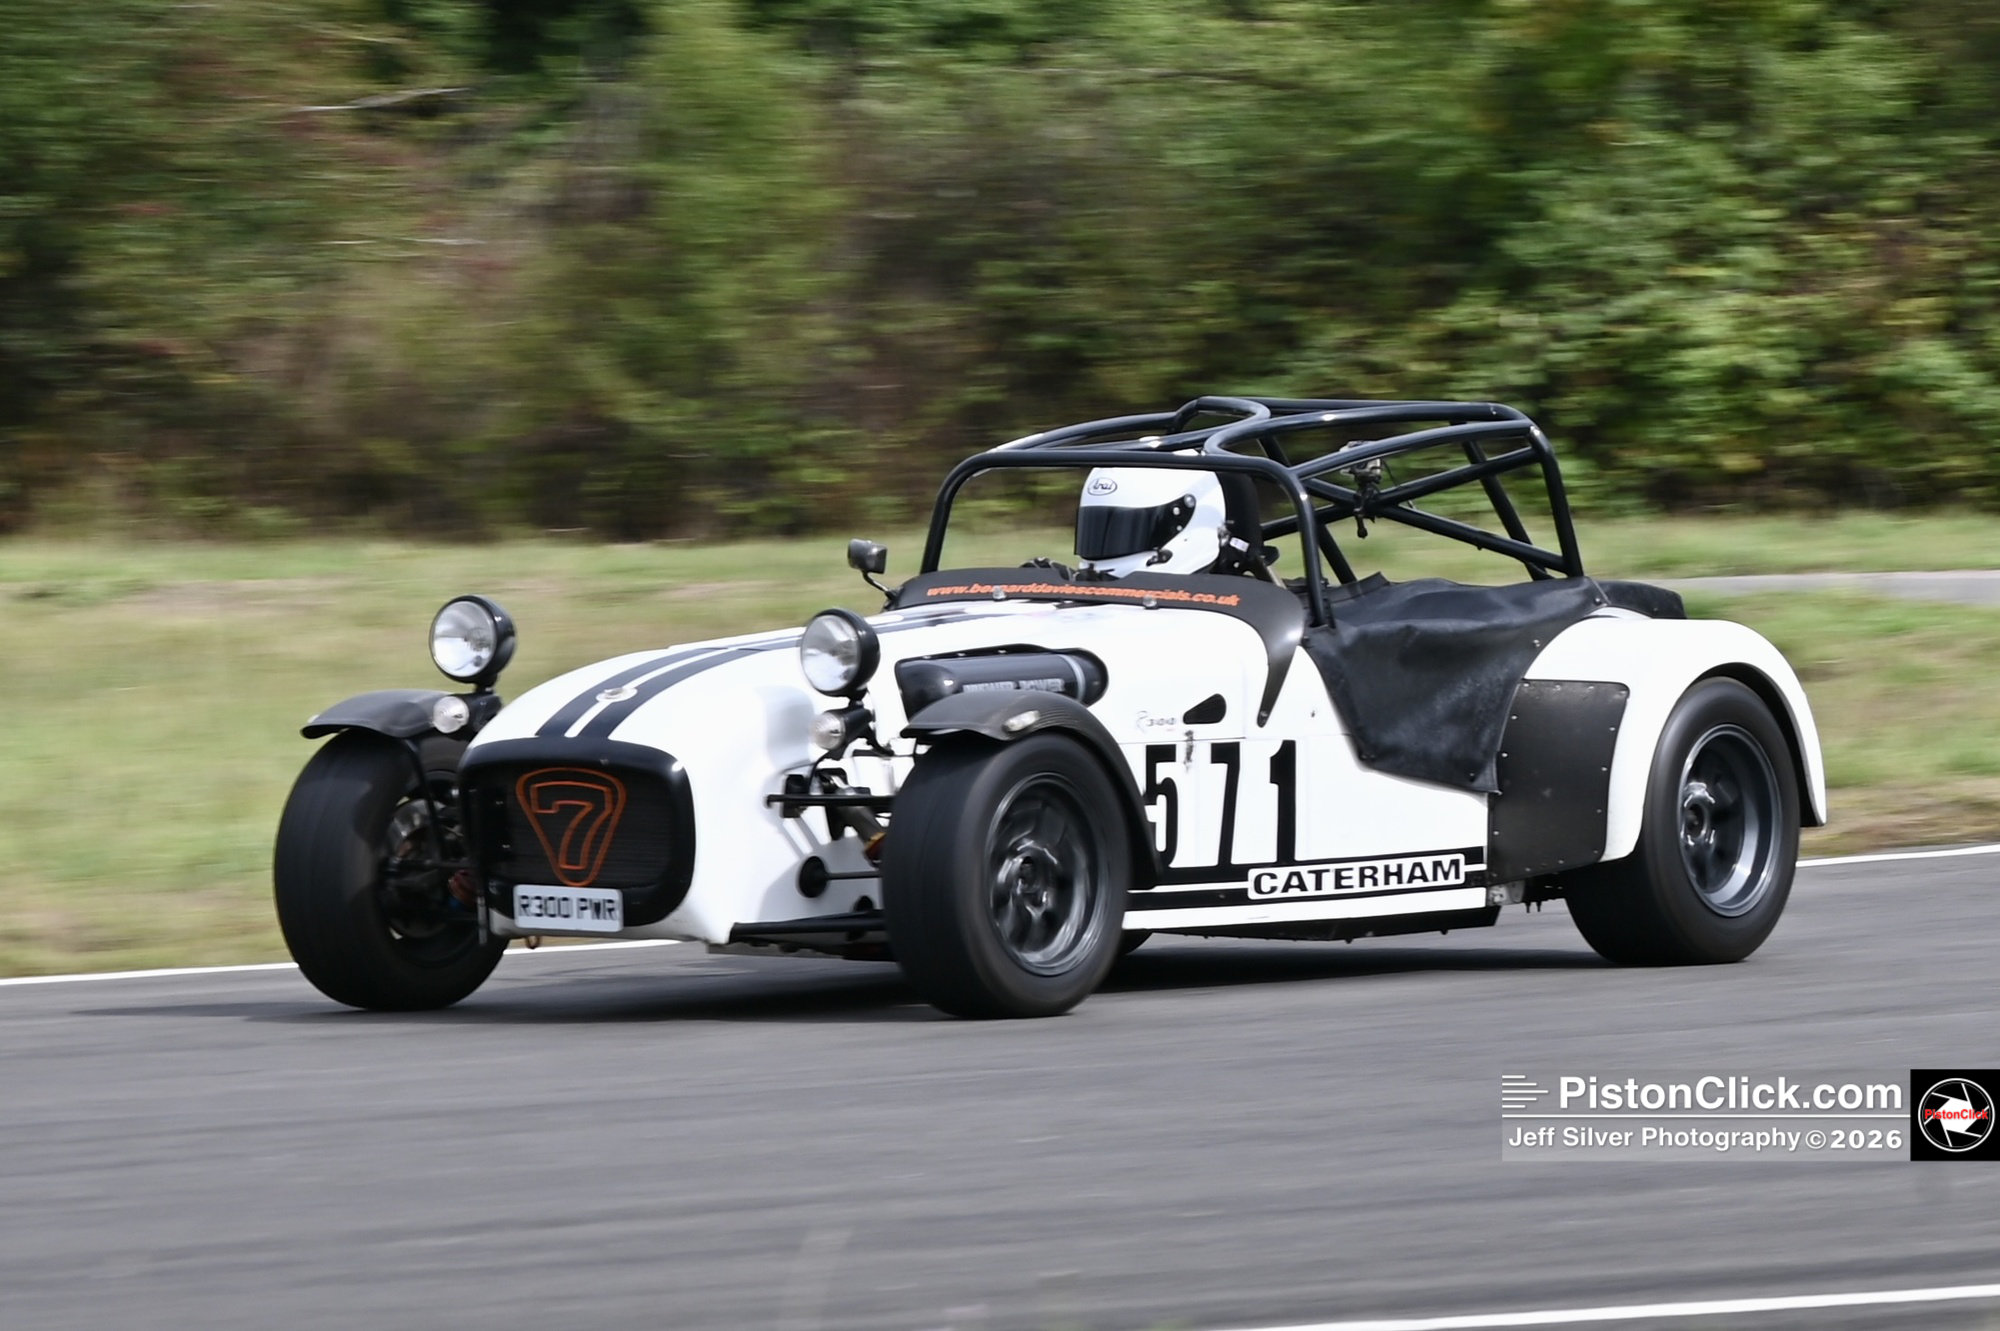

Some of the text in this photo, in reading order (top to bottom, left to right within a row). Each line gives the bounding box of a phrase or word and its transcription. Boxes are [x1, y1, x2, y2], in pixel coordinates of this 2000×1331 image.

[529, 780, 614, 870] 7
[1144, 739, 1297, 867] 571
[517, 894, 619, 921] R300 PWR
[1253, 858, 1461, 896] CATERHAM
